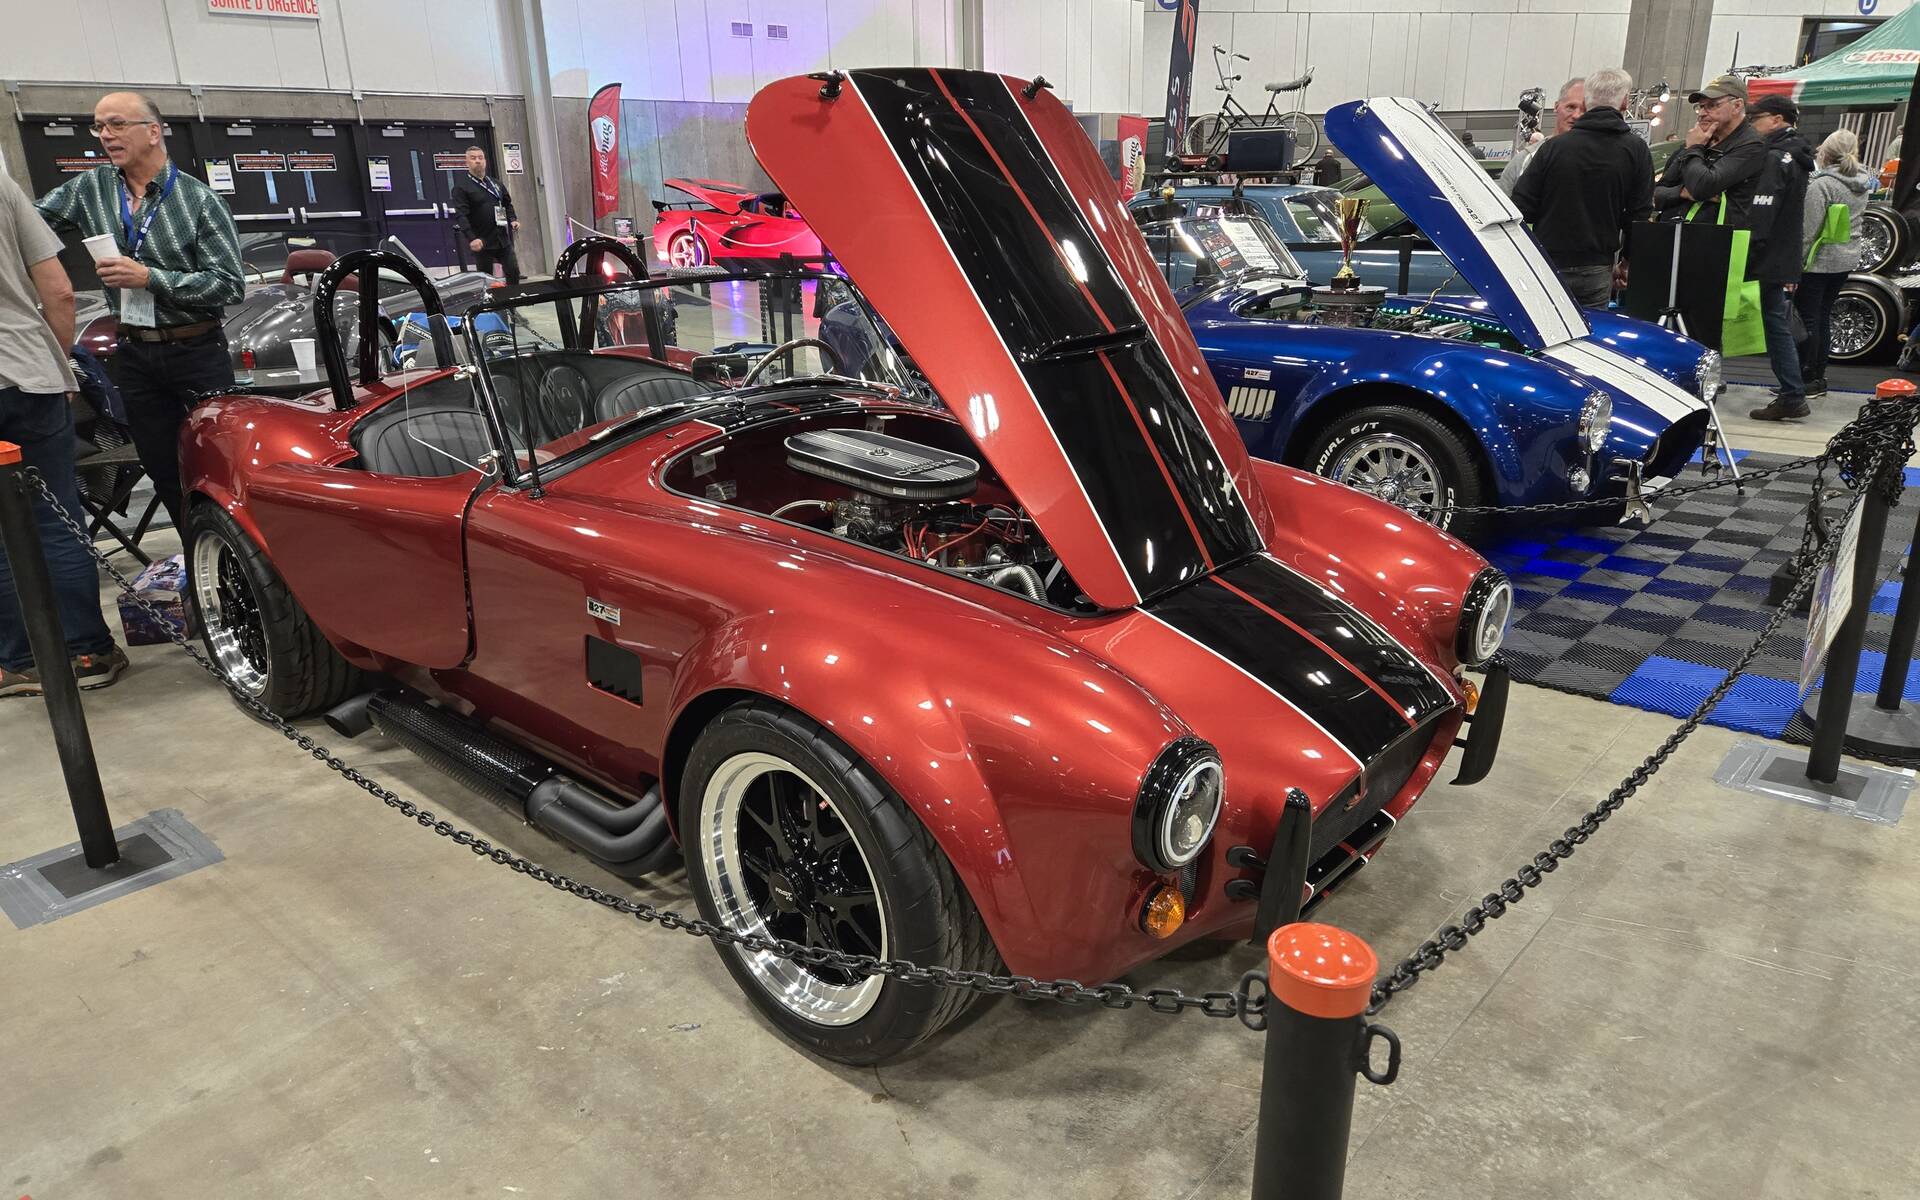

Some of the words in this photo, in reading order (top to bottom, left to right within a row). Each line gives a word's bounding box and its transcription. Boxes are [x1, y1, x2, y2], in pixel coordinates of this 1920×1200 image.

[255, 0, 318, 14] DURGENCE
[1753, 194, 1774, 206] HH
[1466, 207, 1484, 225] 427
[1315, 437, 1345, 476] ADIAL
[1350, 421, 1380, 435] G/T
[1442, 487, 1455, 532] COOP
